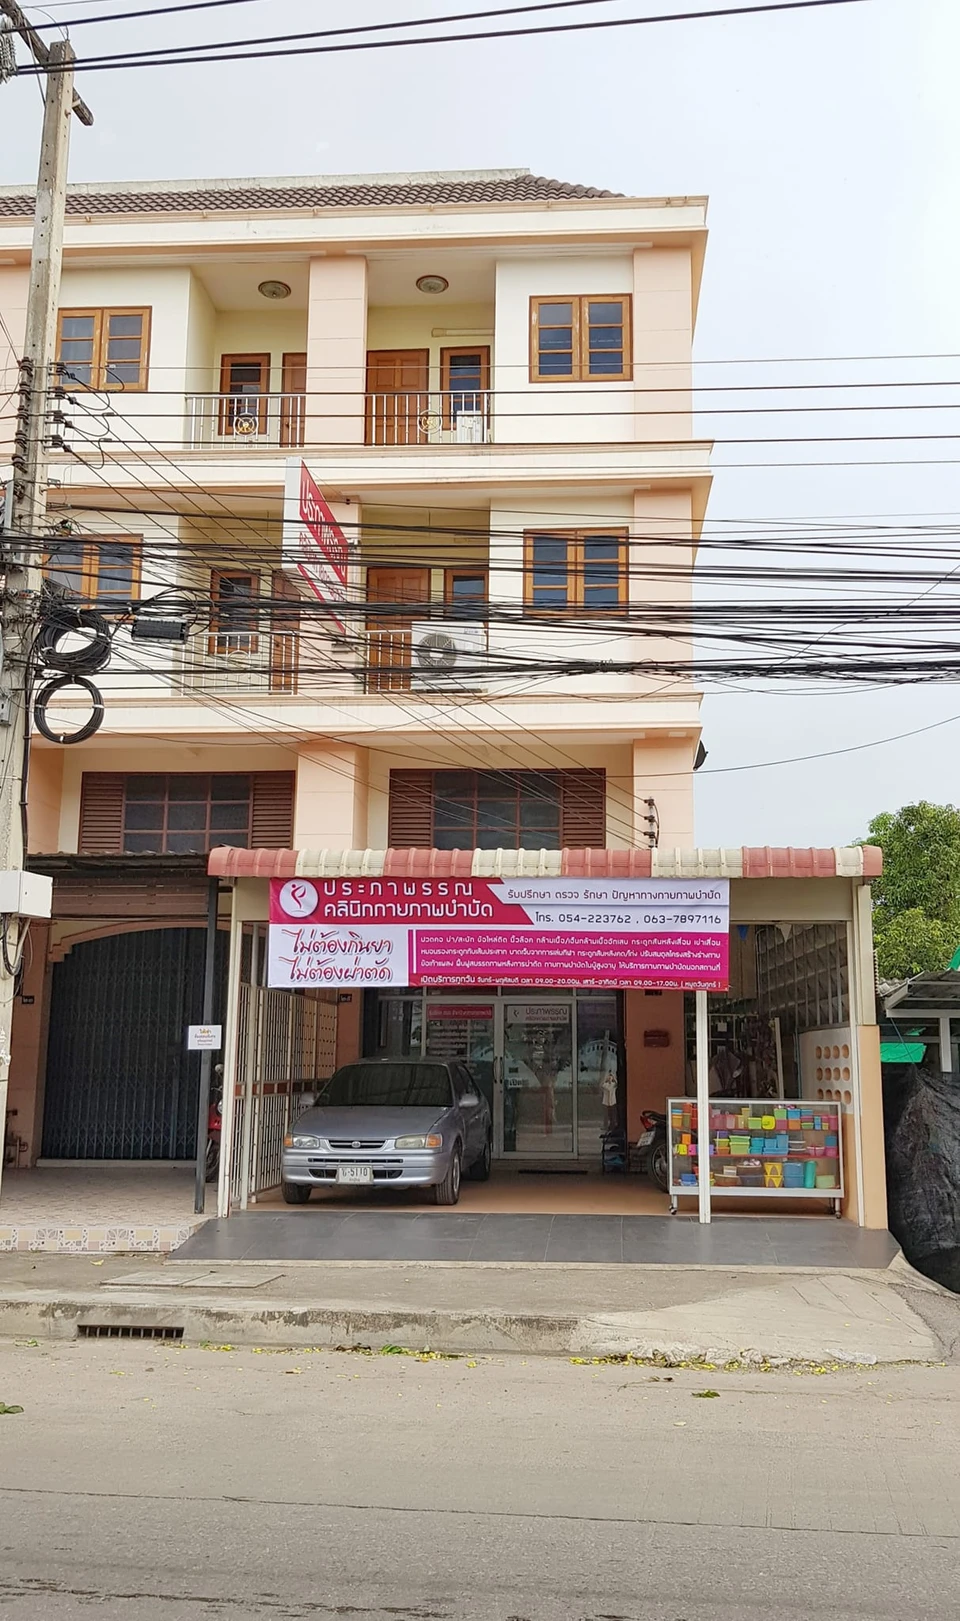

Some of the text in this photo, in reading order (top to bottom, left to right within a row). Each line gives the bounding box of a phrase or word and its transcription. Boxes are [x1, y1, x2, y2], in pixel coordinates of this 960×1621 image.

[324, 881, 473, 896] ประภาพรรณ
[507, 889, 721, 902] รับปรึกษา ตรวจ รักษา ปัญหาทางกายภาพบำบัด
[324, 899, 493, 917] คลินิกกายภาพบำบัด
[535, 911, 554, 923] โทร.
[558, 913, 631, 924] 054-223762
[643, 914, 722, 925] 063-7897116
[281, 928, 393, 955] ไม่ต้องกินยา
[420, 936, 444, 944] ปวดคอ
[477, 935, 508, 944] ข้อไหล่ติด
[694, 937, 721, 947] เข่าเสื่อม
[278, 956, 392, 982] ไม่ต้องผ่าตัด
[420, 974, 475, 985] เปิดบริการทุกวัน
